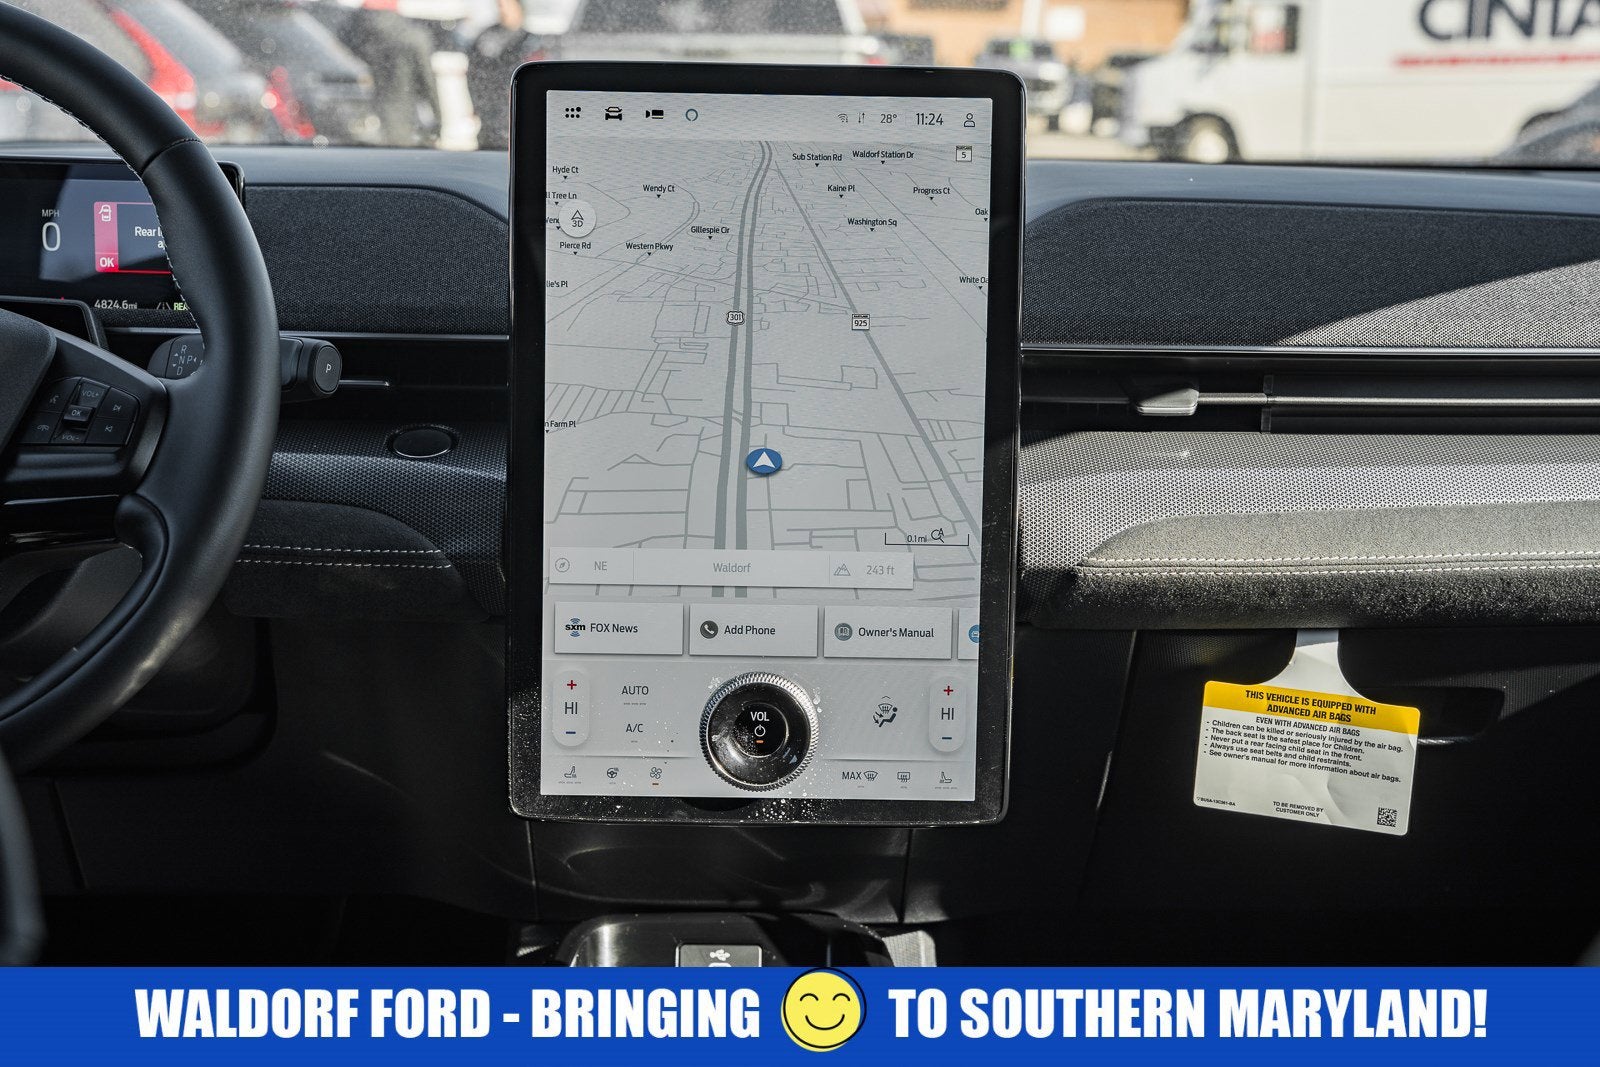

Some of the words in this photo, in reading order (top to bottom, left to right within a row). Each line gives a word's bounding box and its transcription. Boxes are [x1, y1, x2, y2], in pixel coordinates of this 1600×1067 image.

[880, 113, 898, 124] 28°
[915, 113, 944, 126] 11:24
[792, 153, 806, 161] Sub
[807, 153, 831, 161] Station
[832, 153, 842, 161] Rd
[852, 151, 880, 159] Waldorf
[881, 151, 905, 159] Station
[906, 151, 914, 159] Dr
[961, 151, 967, 159] 5
[552, 166, 570, 174] Hyde
[571, 166, 579, 174] Ct
[643, 185, 666, 194] Wendy
[913, 187, 941, 195] Progress
[41, 209, 59, 217] MPH
[975, 208, 988, 216] Oak
[572, 220, 583, 228] 3D
[848, 218, 886, 227] Washington
[888, 219, 898, 227] Sq
[134, 226, 156, 237] Rear
[690, 226, 720, 235] Gillespie
[721, 226, 730, 234] Cir
[42, 222, 61, 251] 0
[655, 243, 674, 251] Pkwy
[100, 257, 114, 267] OK
[959, 276, 979, 284] White
[181, 344, 187, 354] R
[179, 355, 185, 364] N
[187, 355, 193, 364] P
[325, 364, 332, 374] P
[71, 409, 81, 417] OK
[594, 561, 608, 571] NE
[713, 562, 751, 573] Waldorf
[866, 565, 884, 575] 243
[887, 566, 895, 575] ft
[590, 623, 610, 633] FOX
[612, 623, 638, 633] News
[724, 625, 743, 635] Add
[746, 626, 776, 635] Phone
[858, 628, 897, 638] Owner's
[899, 628, 934, 638] Manual
[622, 686, 649, 695] AUTO
[1245, 690, 1264, 699] THIS
[1266, 693, 1300, 704] VEHICLE
[1312, 699, 1352, 711] EQUIPPED
[1355, 704, 1376, 715] WITH
[564, 702, 578, 714] HI
[1267, 704, 1310, 716] ADVANCED
[1313, 710, 1326, 719] AIR
[1329, 712, 1351, 722] BAGS
[750, 712, 770, 722] VOL
[941, 708, 954, 721] HI
[626, 724, 644, 733] A/C
[1256, 717, 1273, 725] EVEN
[1275, 719, 1291, 727] WITH
[1293, 721, 1327, 732] ADVANCED
[1342, 729, 1360, 737] BAGS
[1211, 727, 1224, 735] The
[1226, 729, 1242, 737] back
[1260, 732, 1266, 740] is
[1280, 735, 1300, 745] safest
[1302, 738, 1320, 747] place
[1322, 741, 1332, 749] for
[1333, 743, 1364, 754] Children.
[1212, 720, 1240, 729] Children
[1256, 724, 1265, 732] be
[1267, 726, 1284, 735] killed
[1295, 730, 1326, 741] seriously
[1328, 735, 1352, 745] injured
[1377, 742, 1386, 750] air
[1388, 743, 1403, 753] bag.
[1211, 735, 1230, 743] Never
[1232, 737, 1243, 745] put
[1265, 742, 1286, 751] facing
[1288, 744, 1305, 753] child
[1331, 750, 1342, 758] the
[1344, 752, 1362, 761] front.
[1210, 742, 1234, 751] Always
[1250, 747, 1264, 755] seat
[1265, 749, 1282, 757] belts
[1284, 751, 1296, 759] and
[1298, 752, 1315, 761] child
[1317, 757, 1351, 767] restraints.
[1209, 749, 1222, 757] See
[1223, 751, 1250, 760] owner's
[1251, 755, 1277, 764] manual
[1278, 758, 1287, 766] for
[1308, 762, 1347, 774] information
[1349, 769, 1369, 778] about
[1382, 773, 1401, 783] bags.
[842, 771, 862, 780] MAX
[1276, 807, 1304, 816] CUSTOMER
[1289, 803, 1315, 812] REMOVED
